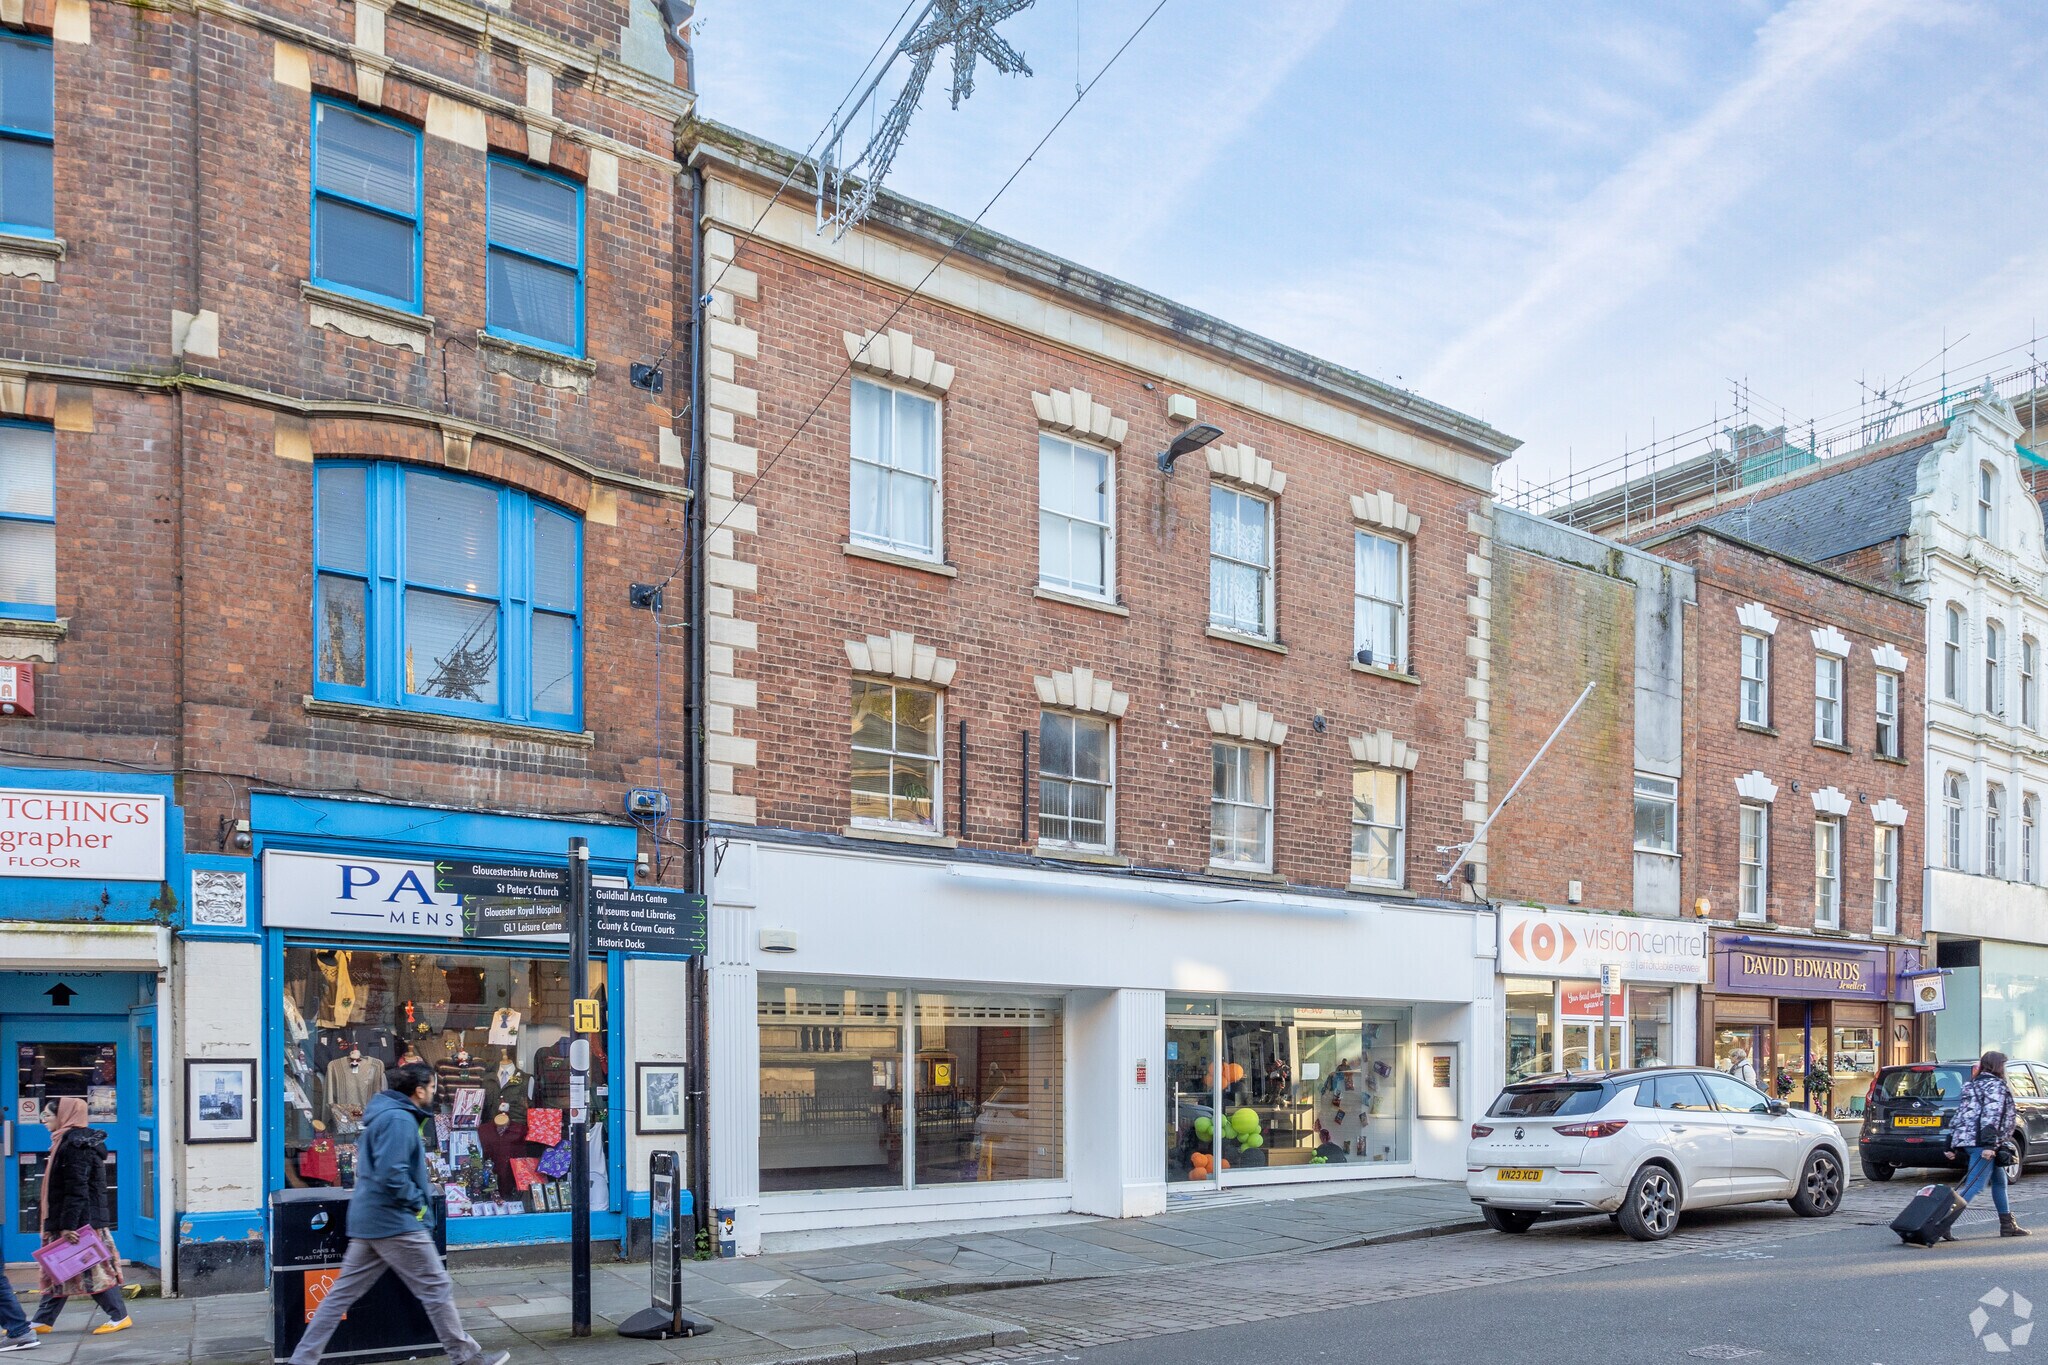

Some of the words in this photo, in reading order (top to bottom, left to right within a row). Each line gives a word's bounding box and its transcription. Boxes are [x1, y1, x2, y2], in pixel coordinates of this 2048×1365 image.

[1, 797, 149, 825] TCHINGS
[0, 825, 113, 854] grapher
[9, 856, 81, 868] FLOOR
[472, 865, 528, 878] Gloucestershire
[529, 868, 559, 880] Archives
[496, 883, 506, 893] St
[507, 884, 532, 895] Peter's
[533, 885, 559, 897] Church
[596, 889, 629, 901] Guildhall
[630, 892, 644, 903] Arts
[645, 893, 668, 904] Centre
[484, 907, 516, 917] Gloucester
[517, 906, 535, 917] Royal
[536, 904, 562, 916] Hospital
[631, 908, 645, 918] and
[646, 909, 677, 920] Libraries
[390, 911, 463, 927] MENS
[504, 922, 516, 932] GL1
[518, 922, 541, 932] Leisure
[541, 921, 562, 931] Centre
[622, 921, 629, 931] &
[630, 922, 652, 933] Crown
[653, 924, 676, 935] Courts
[597, 937, 624, 948] Historic
[625, 938, 646, 949] Docks
[1583, 928, 1701, 957] visioncentre
[1743, 955, 1789, 976] DAVID
[1793, 958, 1860, 981] EDWARDS
[1838, 980, 1867, 991] Jewellers
[578, 1003, 596, 1029] H
[1501, 1170, 1522, 1180] VN23
[1522, 1170, 1540, 1181] XCD
